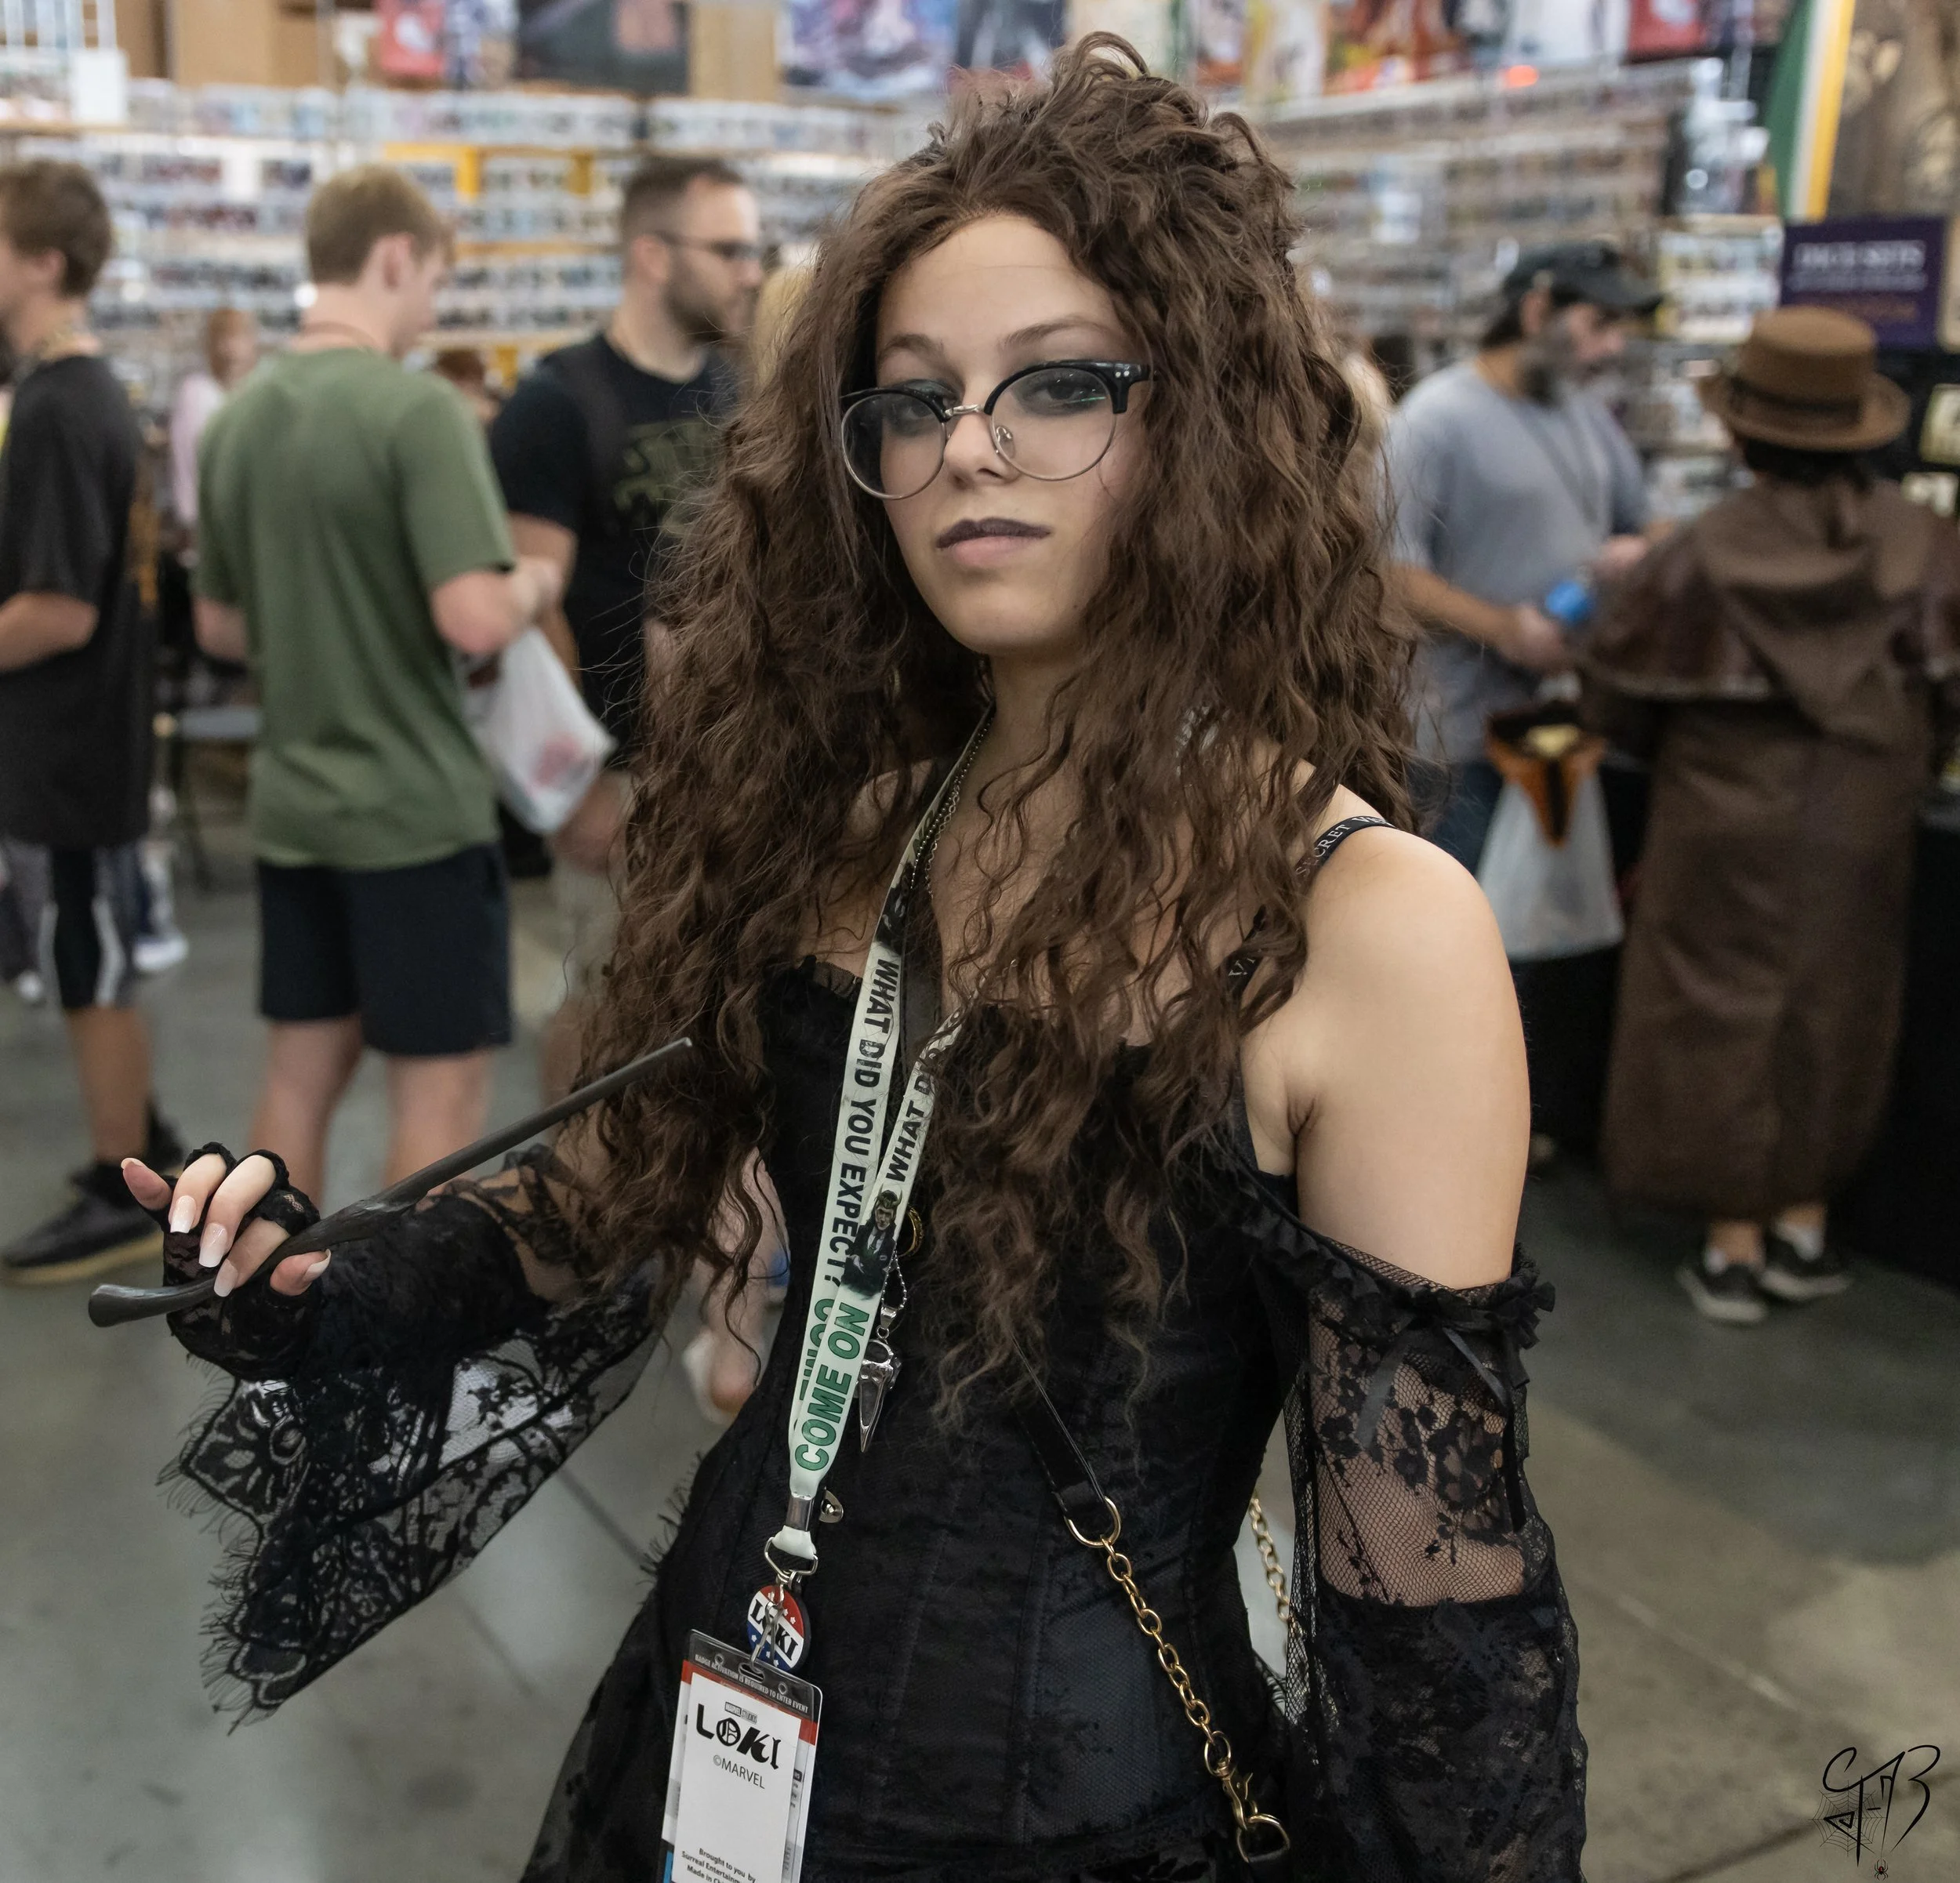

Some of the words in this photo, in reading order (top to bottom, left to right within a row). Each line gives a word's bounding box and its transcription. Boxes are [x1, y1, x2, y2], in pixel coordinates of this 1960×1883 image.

[1295, 824, 1351, 876] SCRET
[864, 959, 899, 1034] WHAT
[855, 1039, 886, 1088] DID
[844, 1098, 877, 1156] YOU
[886, 1100, 926, 1182] WHAT
[795, 1365, 852, 1471] COME
[828, 1301, 869, 1359] ON
[711, 1663, 739, 1679] ACTIVATION
[739, 1674, 744, 1683] IS
[744, 1678, 768, 1694] REQUIRED
[776, 1693, 792, 1705] ENTER
[793, 1700, 808, 1713] EVENT
[696, 1703, 782, 1770] LOKI
[681, 1851, 704, 1867] Surreal
[687, 1865, 705, 1878] Made
[706, 1874, 712, 1882] in
[699, 1848, 724, 1867] Brought
[726, 1862, 733, 1870] to
[734, 1867, 745, 1878] you
[748, 1873, 756, 1883] by
